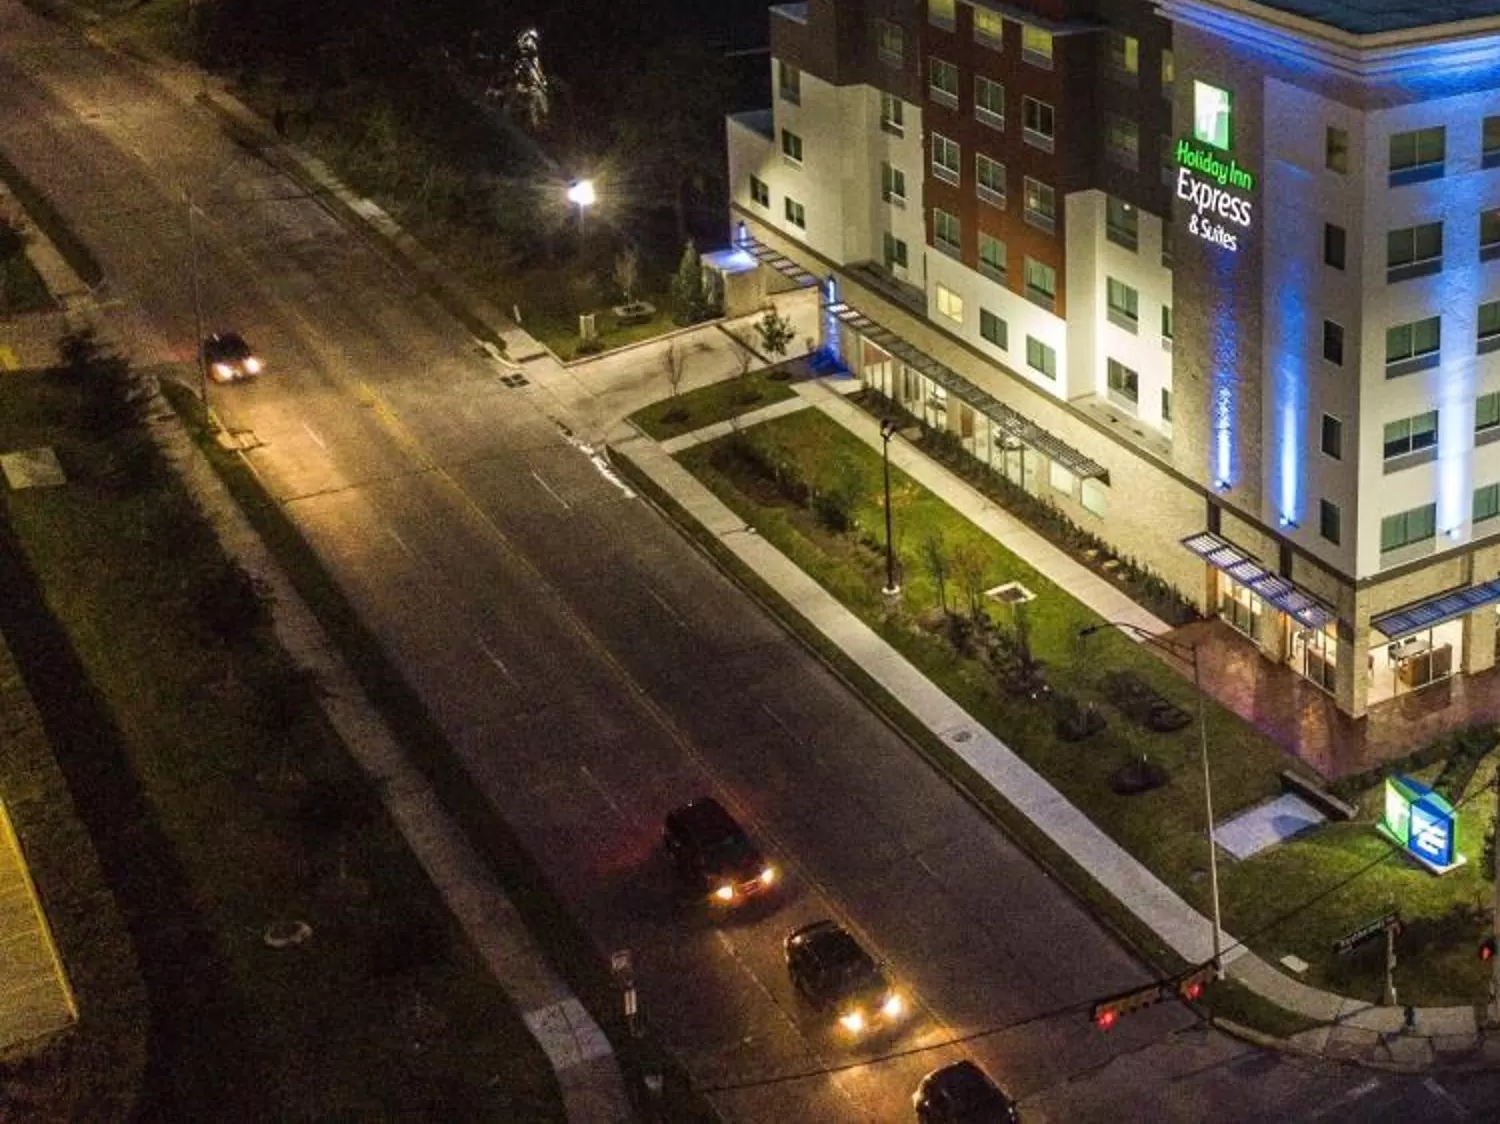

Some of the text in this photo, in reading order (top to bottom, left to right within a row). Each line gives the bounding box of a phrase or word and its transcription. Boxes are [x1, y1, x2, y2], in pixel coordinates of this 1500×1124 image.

[1177, 140, 1253, 190] Holiday Inn
[1177, 167, 1252, 226] Express
[1189, 215, 1237, 252] & Suites
